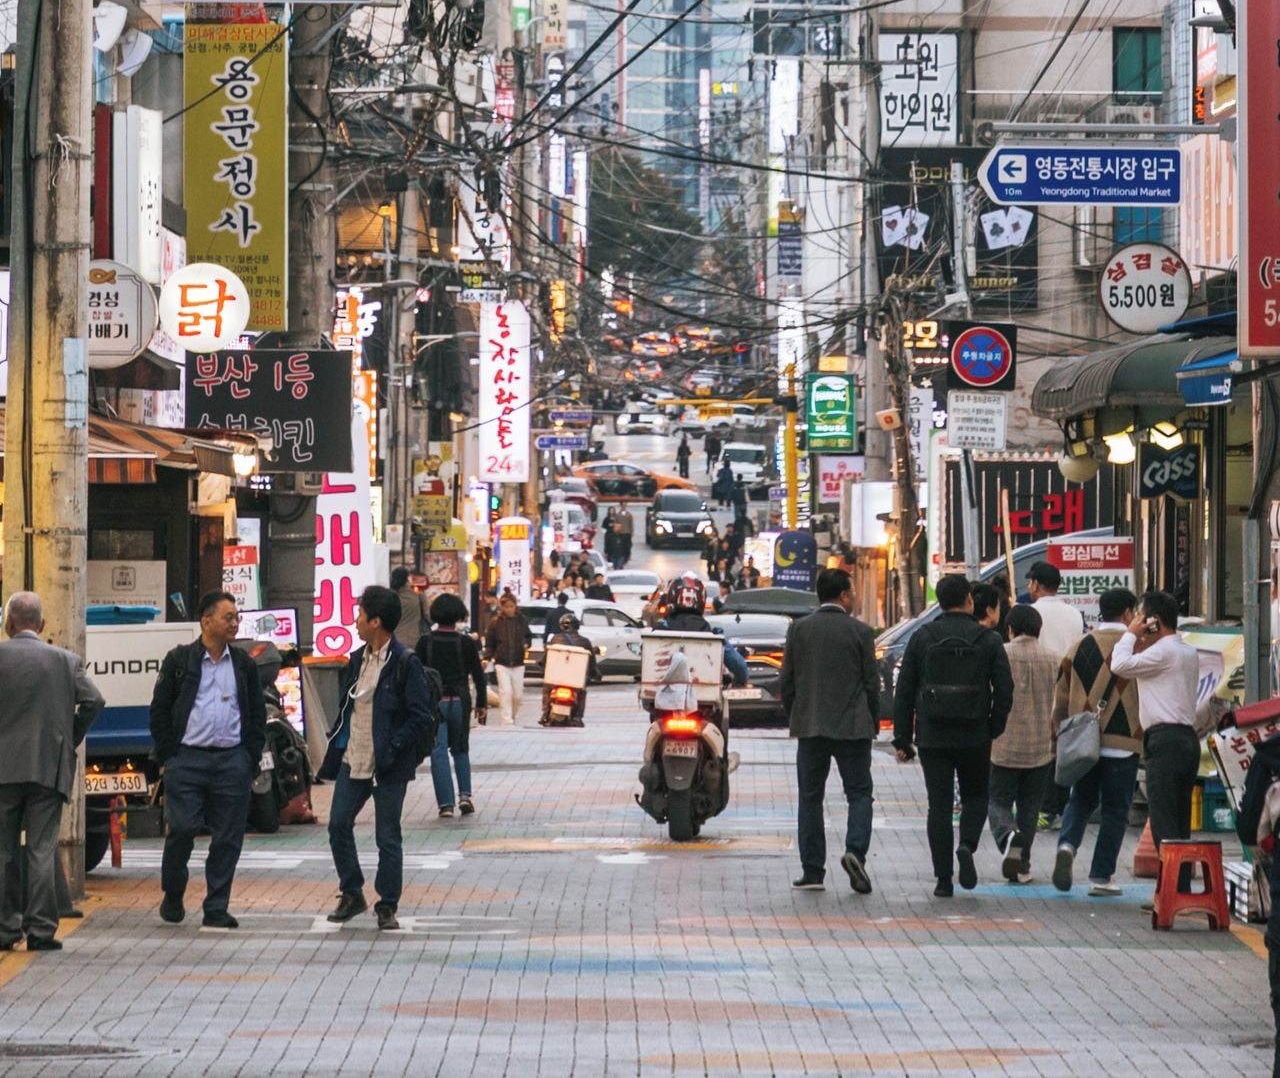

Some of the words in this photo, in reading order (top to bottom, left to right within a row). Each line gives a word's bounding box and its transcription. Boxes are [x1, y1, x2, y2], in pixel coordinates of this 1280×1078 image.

[885, 92, 950, 131] 한의원
[216, 60, 257, 243] 용문정사
[1035, 157, 1137, 180] 영동전통시장
[1141, 157, 1176, 180] 입구
[1040, 187, 1090, 198] Yeongdong
[1092, 187, 1138, 197] Traditional
[1140, 187, 1171, 197] Market
[1107, 253, 1181, 283] 삼겹살
[178, 279, 236, 337] 닭
[193, 353, 258, 398] 부산
[993, 489, 1084, 534] 노래
[1062, 545, 1119, 561] 점심특선
[222, 567, 252, 583] 정식
[112, 776, 141, 791] 3630
